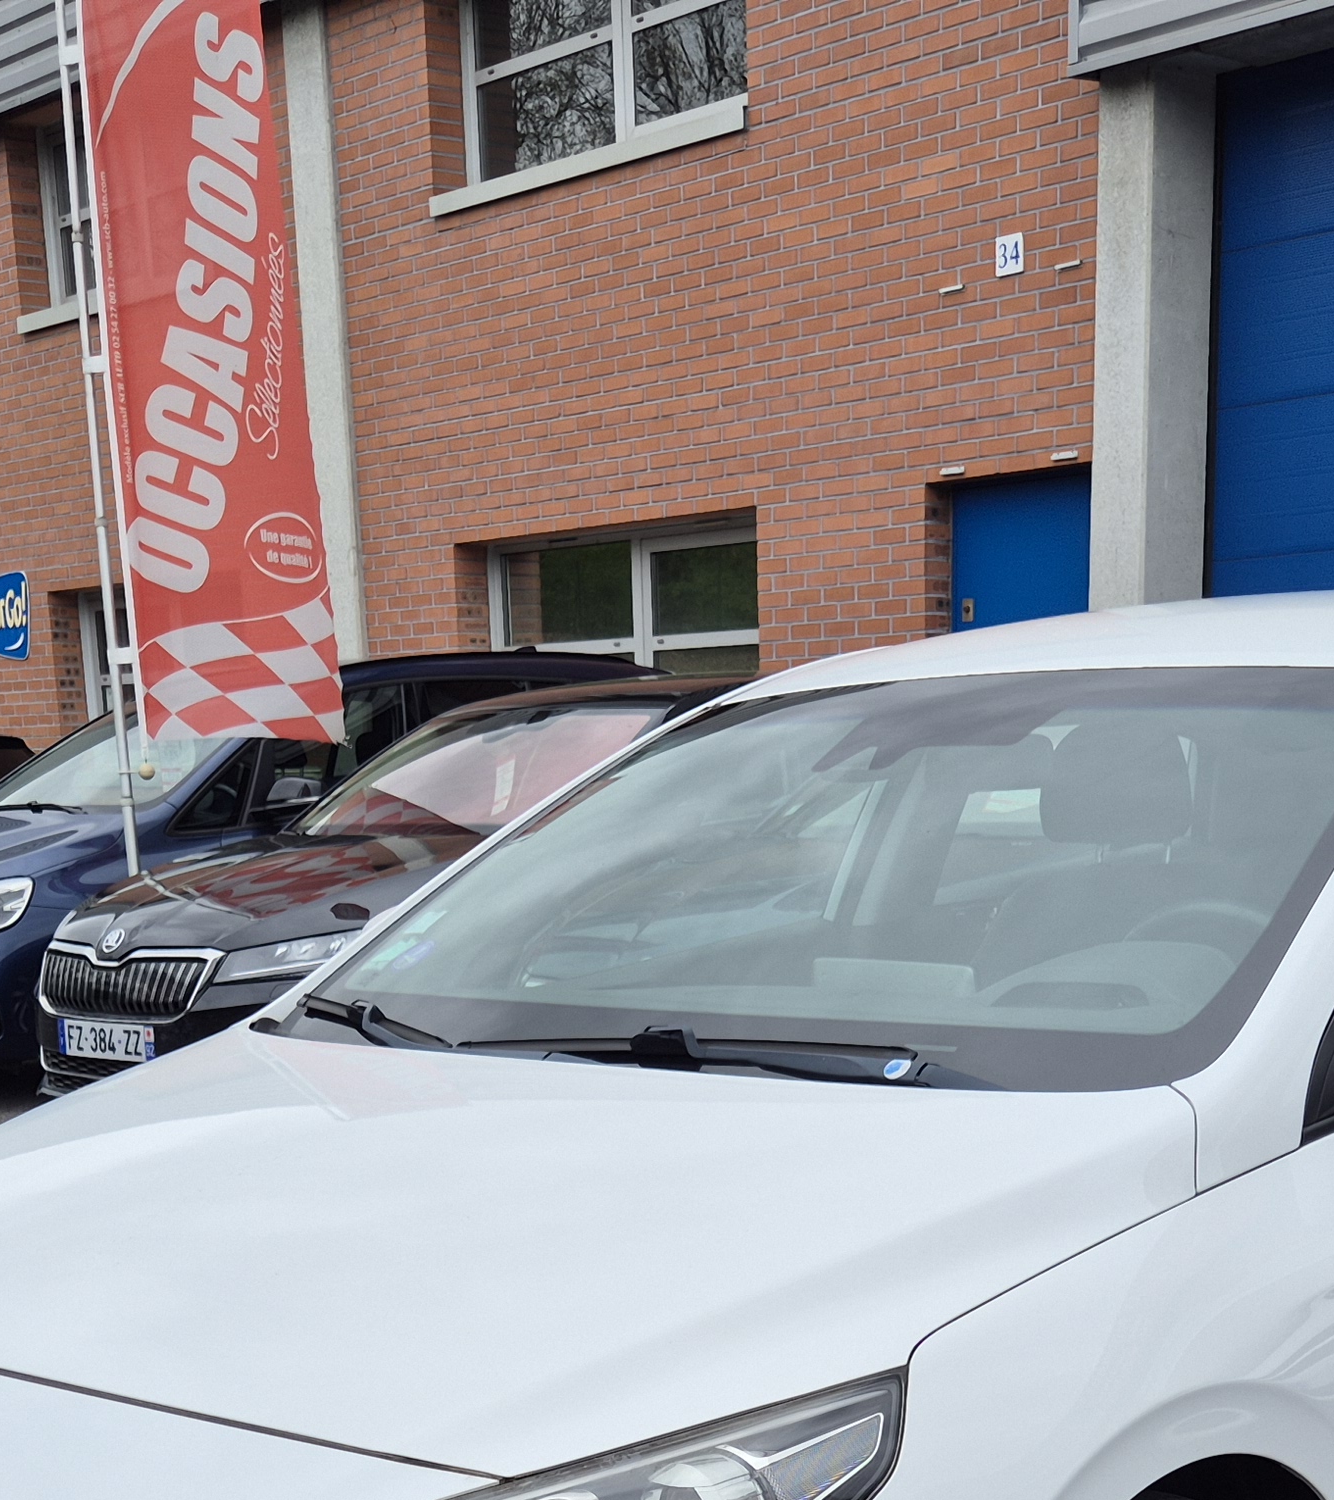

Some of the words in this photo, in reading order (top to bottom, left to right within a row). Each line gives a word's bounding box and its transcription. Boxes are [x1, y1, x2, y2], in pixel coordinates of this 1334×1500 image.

[998, 240, 1021, 269] 34
[126, 10, 265, 593] OCCASIONS
[260, 529, 279, 544] Une
[266, 549, 280, 563] de
[67, 1024, 143, 1056] FZ-384-ZZ
